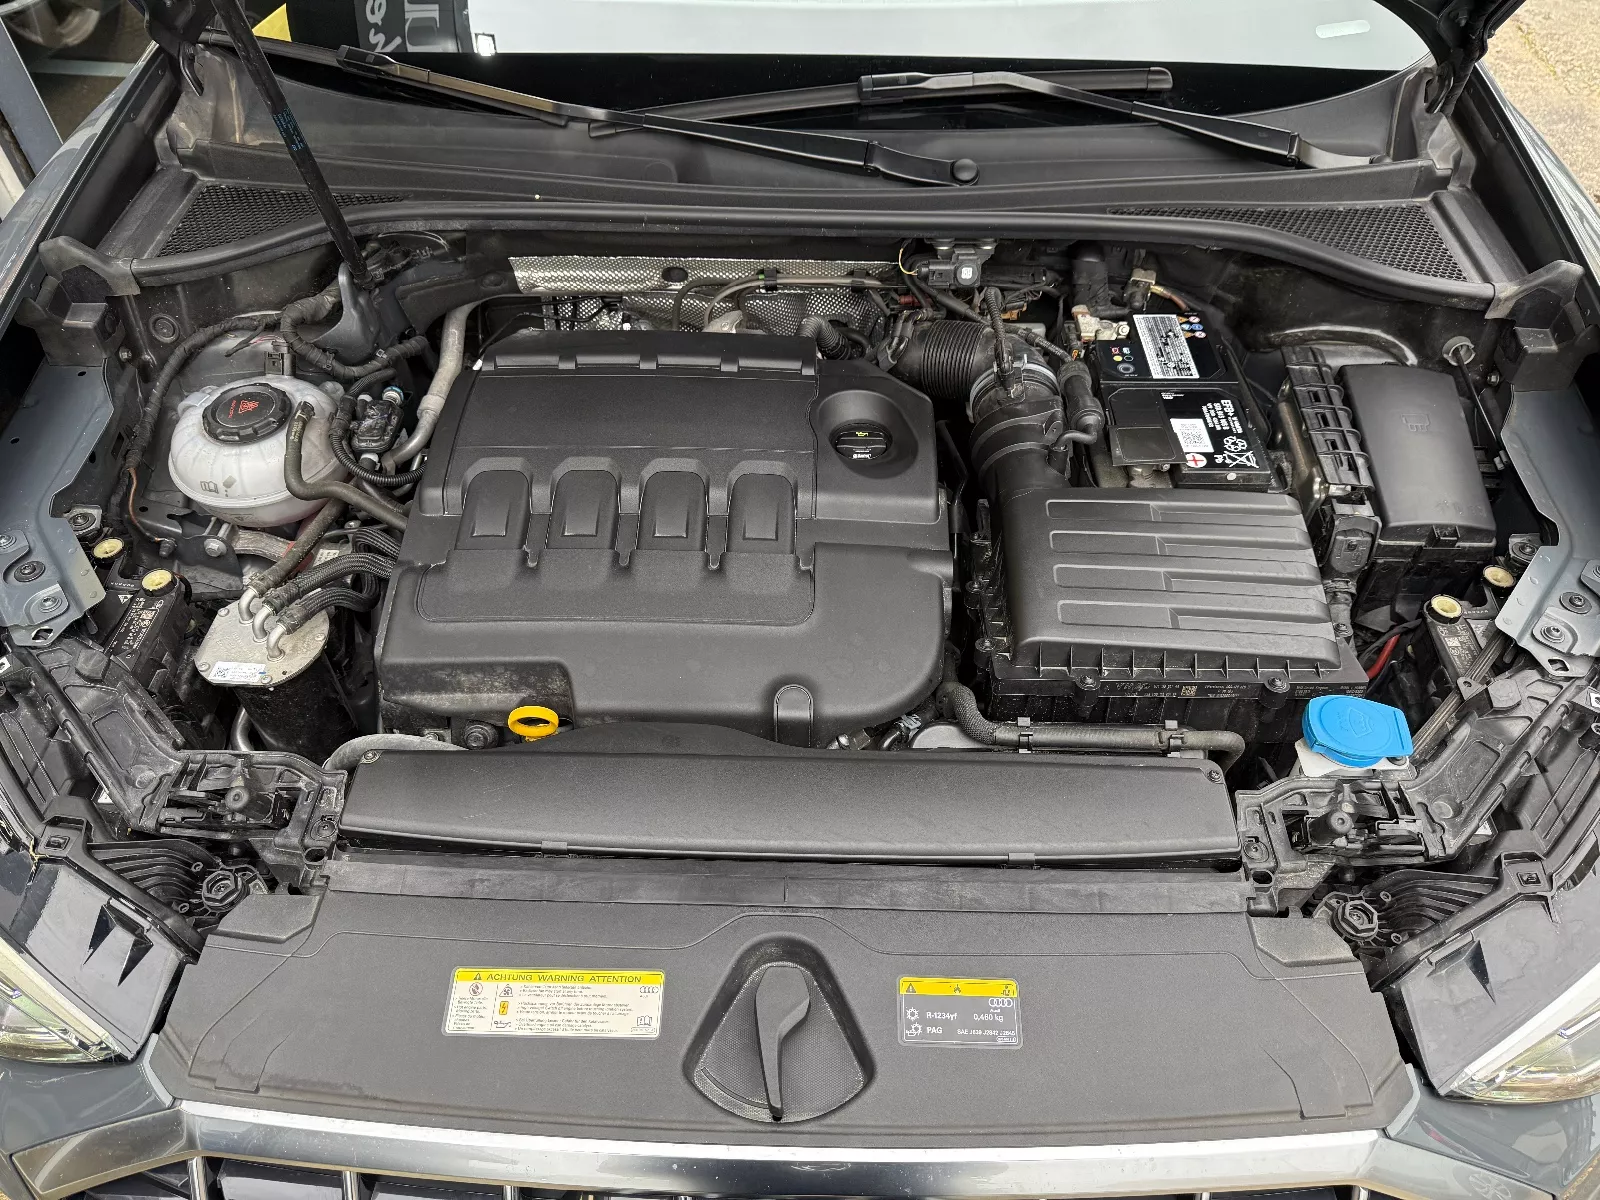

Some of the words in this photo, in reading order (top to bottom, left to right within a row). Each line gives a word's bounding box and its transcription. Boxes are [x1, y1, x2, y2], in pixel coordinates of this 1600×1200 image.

[486, 973, 533, 982] ACHTUNG
[537, 974, 585, 982] WARNING
[588, 975, 643, 983] ATTENTION
[926, 1011, 958, 1021] R-1234yf
[994, 1013, 1004, 1023] kg
[926, 1026, 943, 1034] PAG
